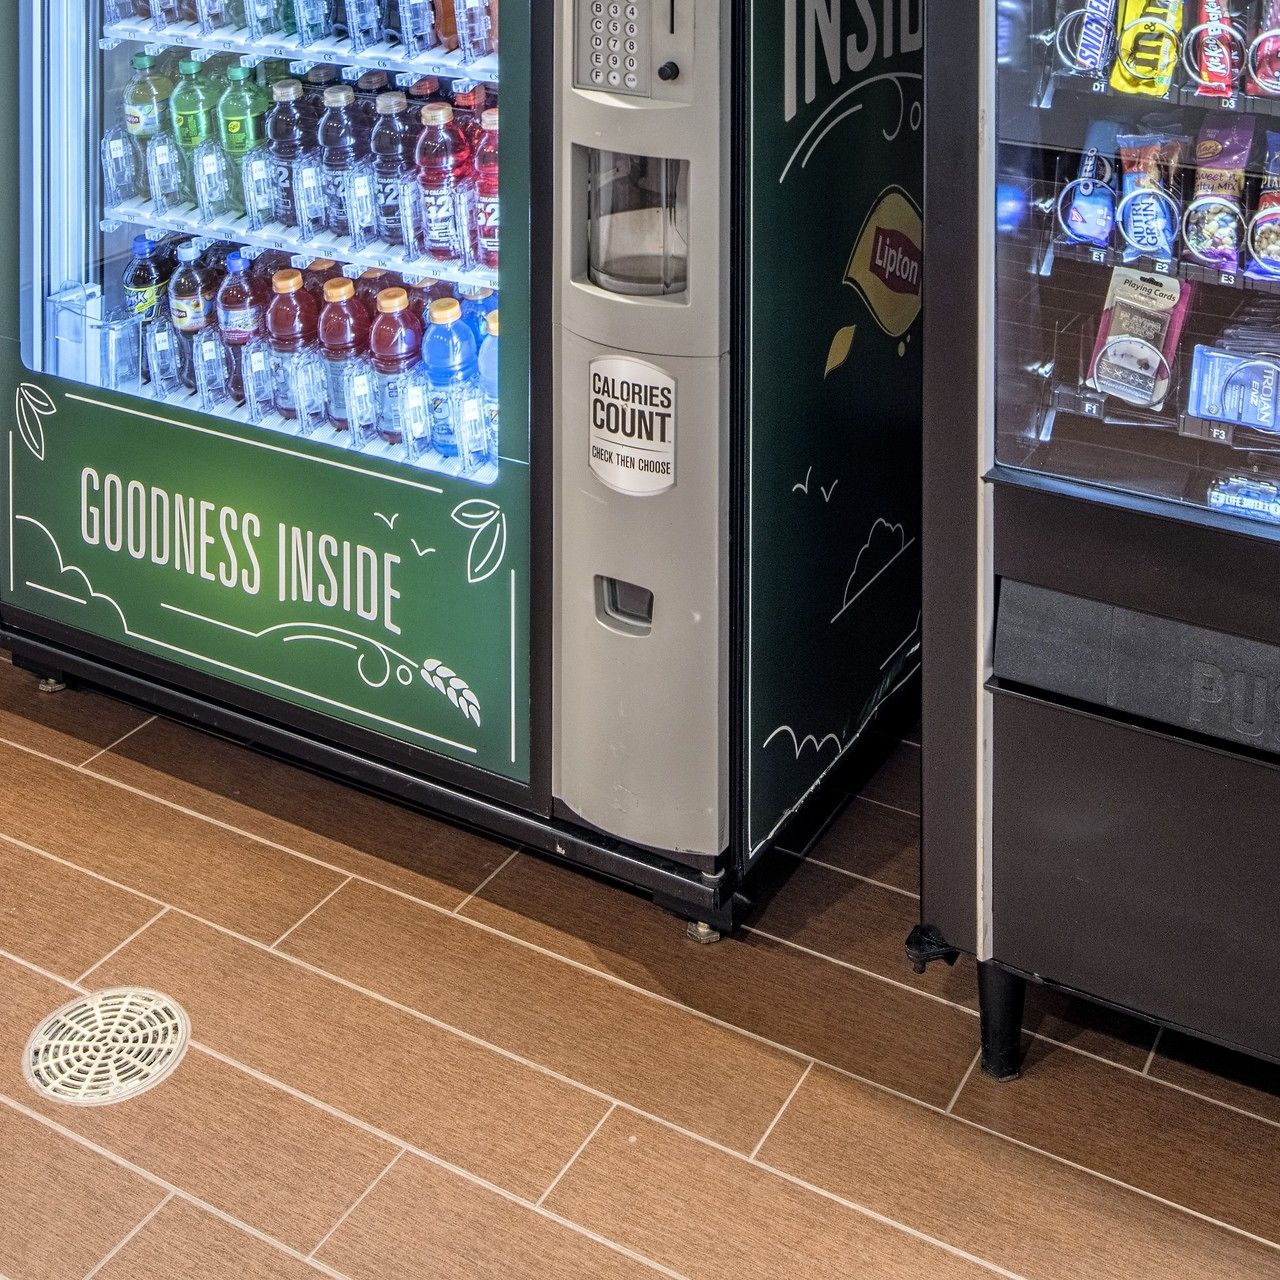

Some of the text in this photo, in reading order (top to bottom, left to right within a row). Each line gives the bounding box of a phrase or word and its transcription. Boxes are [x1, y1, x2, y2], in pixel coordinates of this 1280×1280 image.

[1092, 82, 1105, 92] D1
[1221, 99, 1235, 108] D3
[1079, 147, 1097, 196] OREO
[1131, 200, 1144, 246] NUTRI
[1145, 199, 1158, 247] GRAIN
[875, 234, 919, 286] Lipton
[1092, 251, 1105, 262] E1
[1155, 262, 1169, 272] E2
[1124, 278, 1176, 302] Playing Cards
[1221, 274, 1234, 284] E3
[592, 372, 672, 409] CALORIES
[1249, 380, 1260, 407] ENZ
[1257, 369, 1275, 423] TROJAN
[592, 397, 671, 443] COUNT
[1085, 403, 1097, 414] F1
[1212, 429, 1226, 440] F3
[592, 445, 671, 475] CHECK THEN CHOOSE
[81, 466, 402, 635] GOODNESS INSIDE
